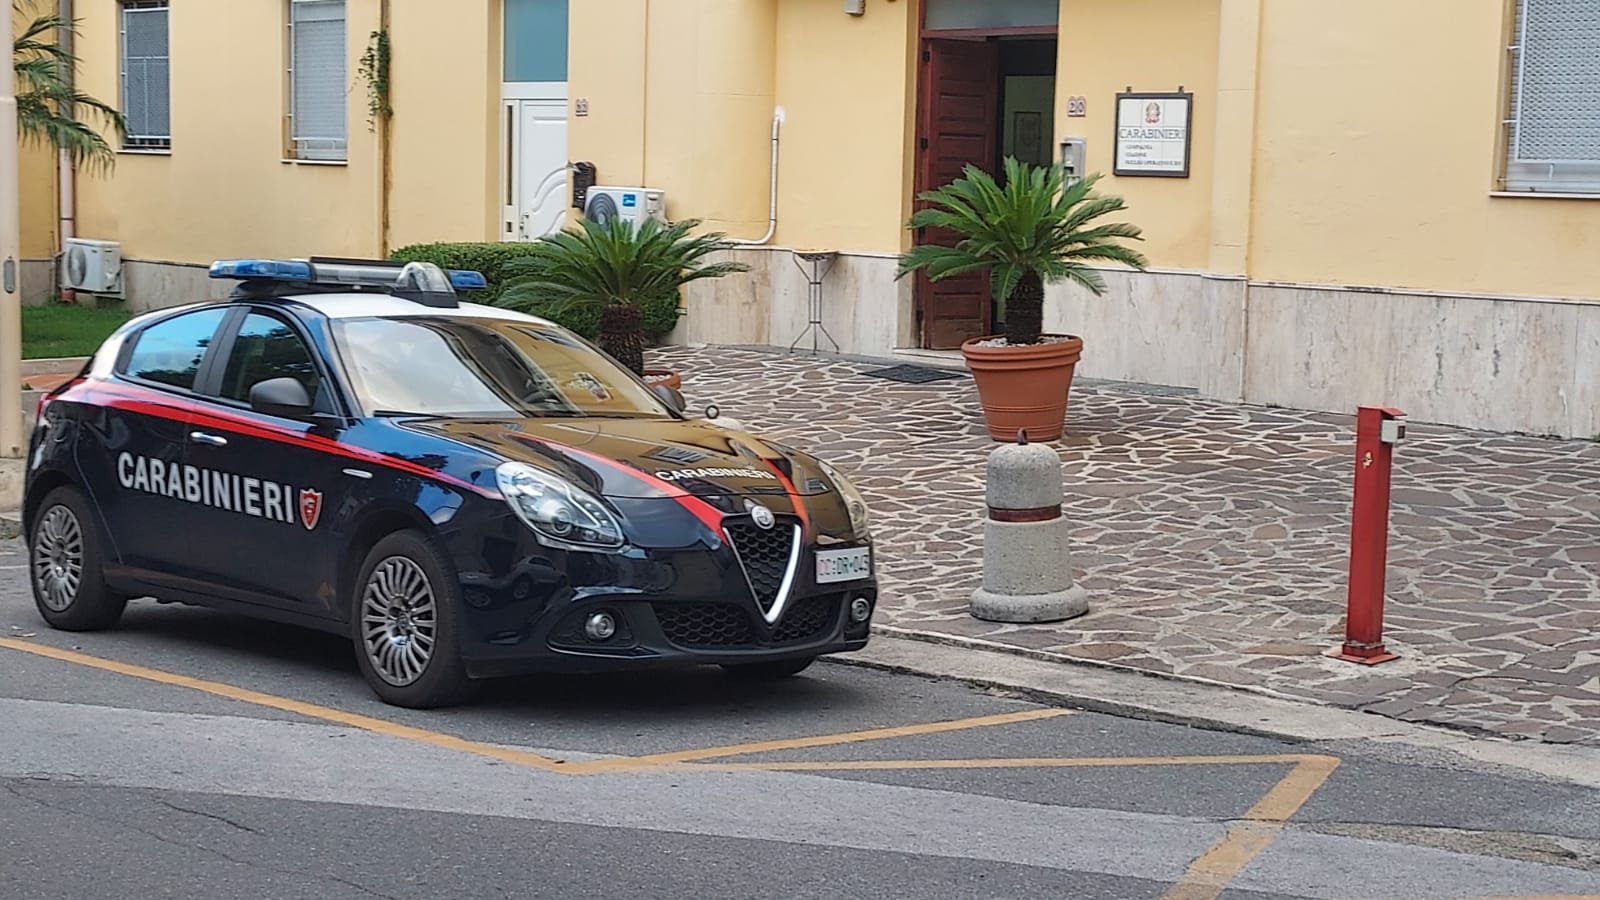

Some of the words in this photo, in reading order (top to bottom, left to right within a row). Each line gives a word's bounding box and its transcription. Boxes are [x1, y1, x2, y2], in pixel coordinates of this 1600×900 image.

[1119, 128, 1185, 139] CARABINIERI
[655, 466, 776, 480] CARABINIERI
[118, 451, 294, 524] CARABINIERI
